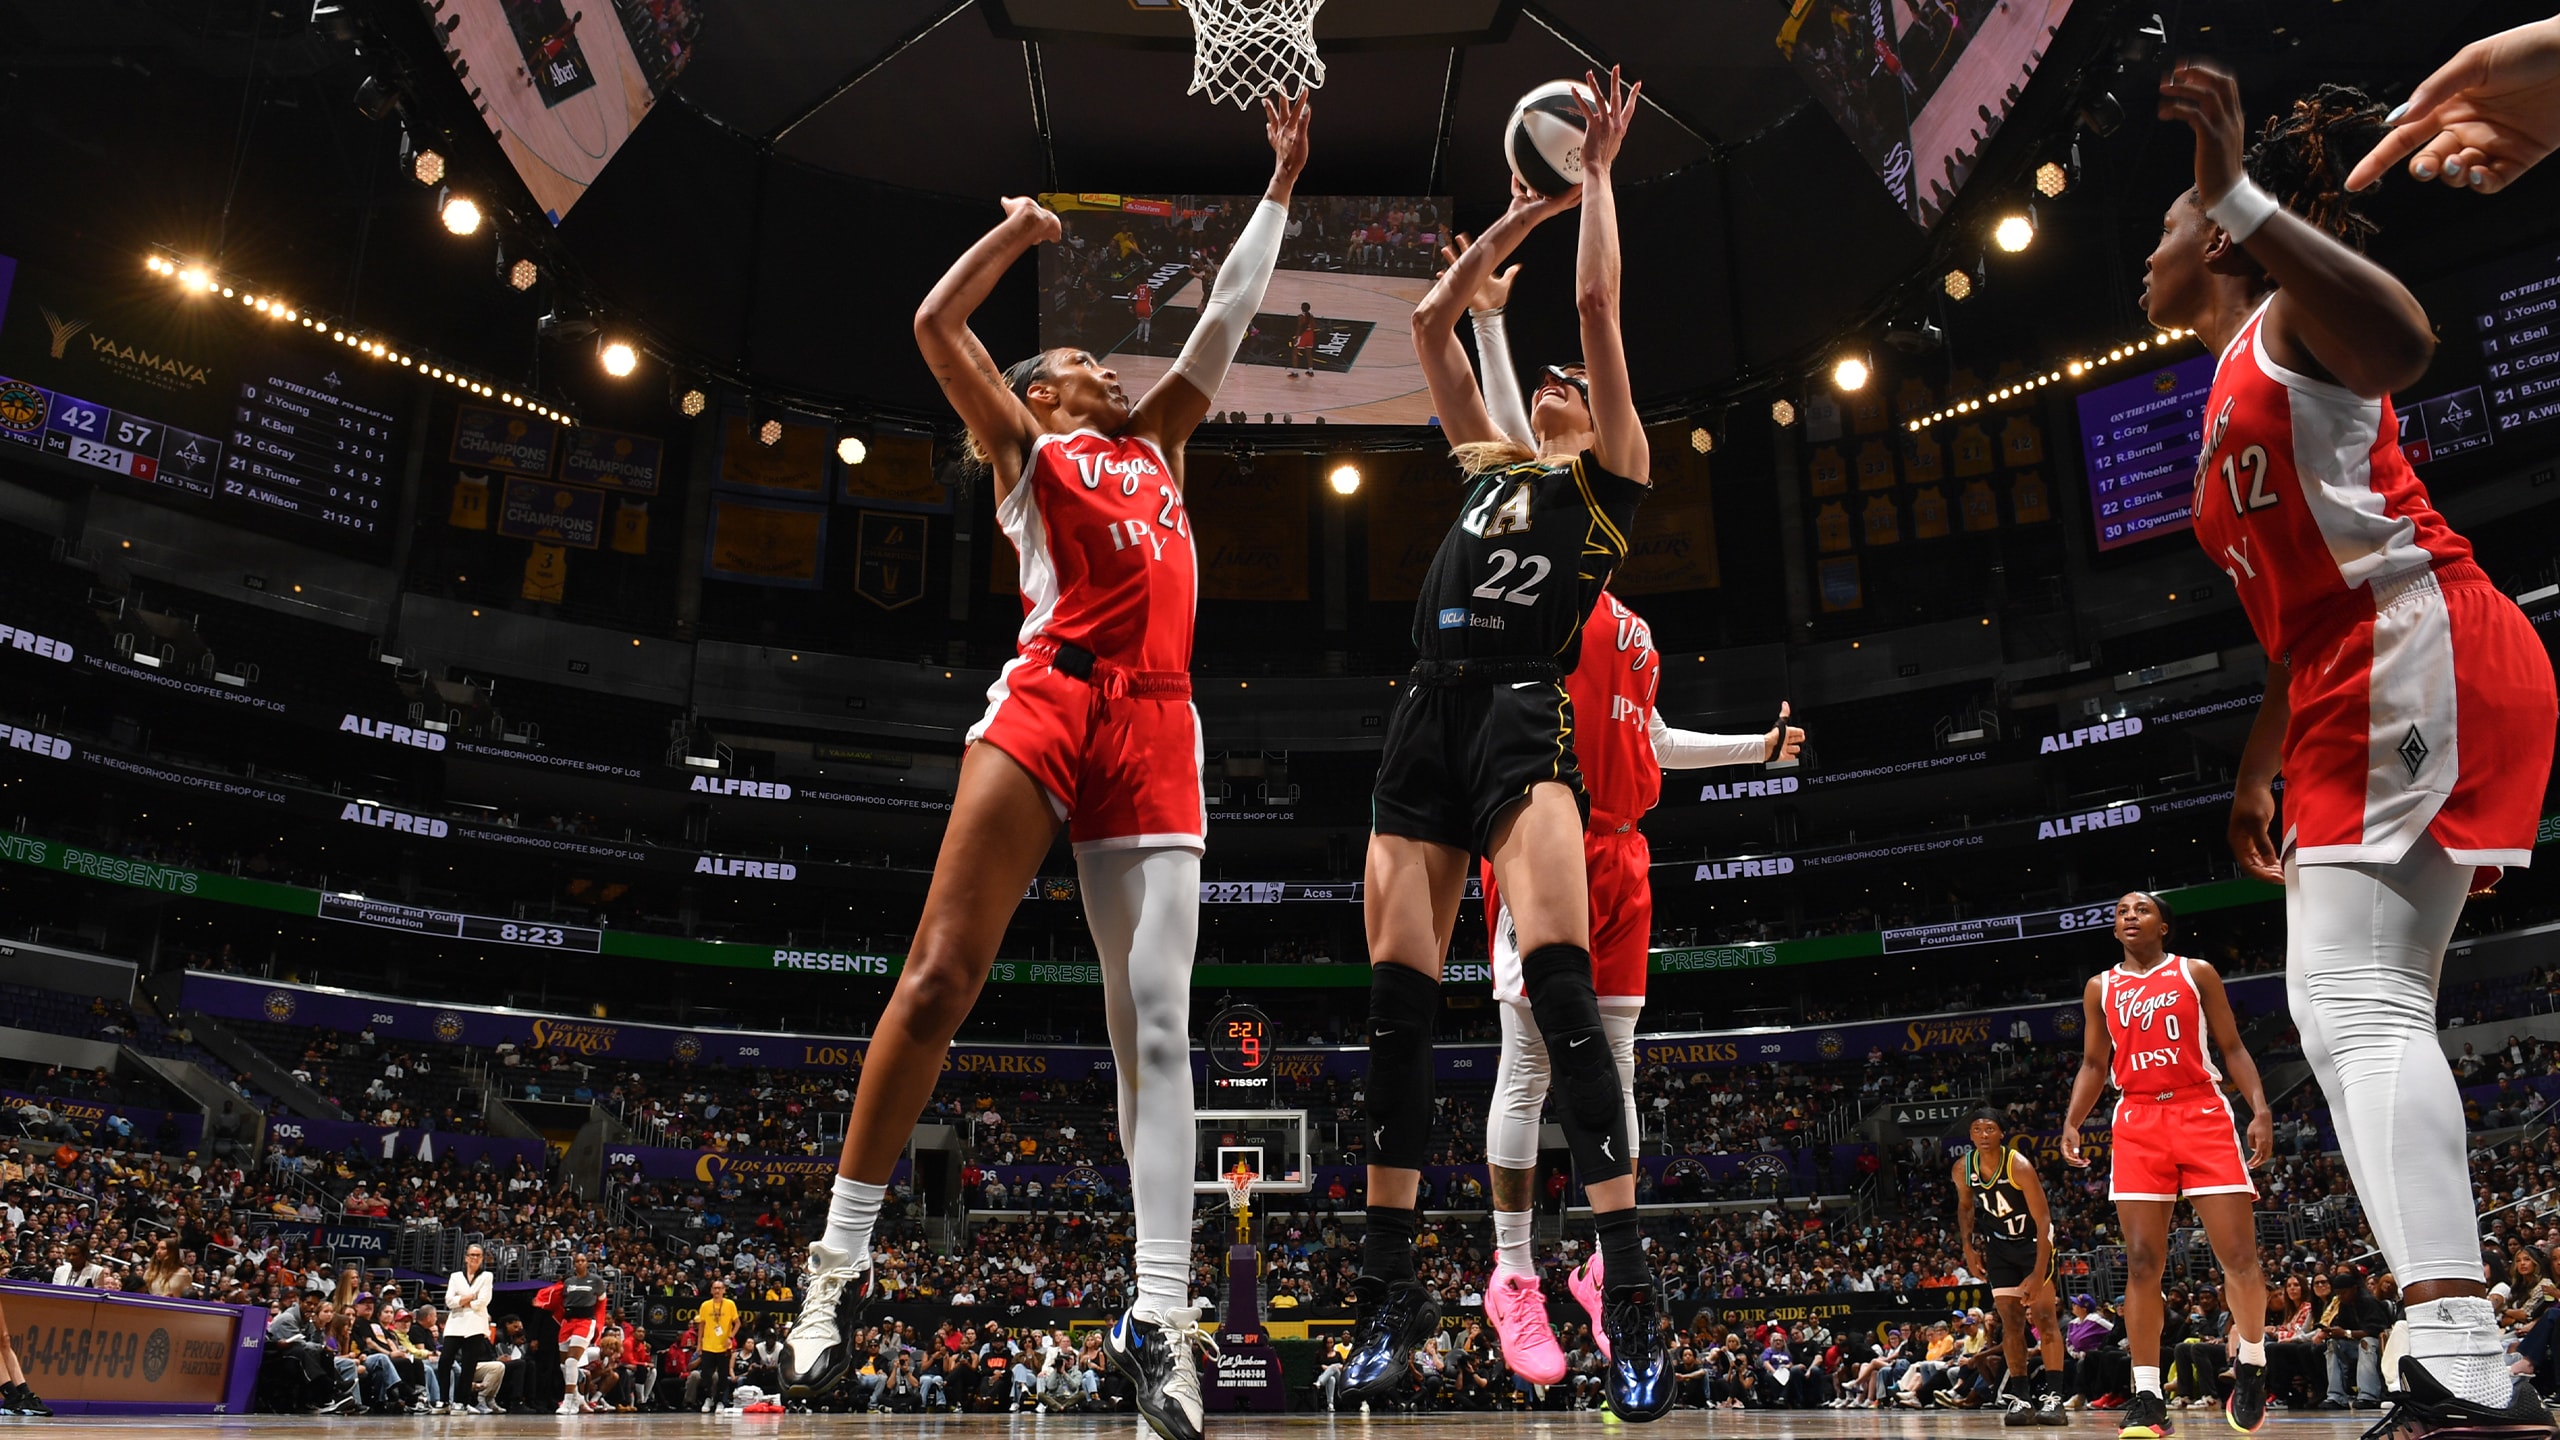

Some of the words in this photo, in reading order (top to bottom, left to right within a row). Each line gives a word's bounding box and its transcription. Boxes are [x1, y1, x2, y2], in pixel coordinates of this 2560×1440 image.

[550, 60, 577, 88] Albert
[2484, 315, 2493, 328] 0
[2504, 299, 2557, 322] J.Young
[1314, 332, 1352, 356] Albert
[2490, 339, 2498, 352] 1
[2510, 326, 2548, 346] K.Bell
[2490, 363, 2510, 379] 12
[2516, 352, 2560, 370] C.Gray
[247, 387, 255, 398] 0
[265, 395, 310, 417] J.Young
[268, 377, 284, 387] ON
[284, 382, 306, 394] THE
[305, 388, 338, 405] FLOOR
[2495, 389, 2514, 404] 21
[61, 407, 96, 432] 42
[2110, 411, 2125, 423] ON
[2125, 406, 2145, 419] THE
[2146, 396, 2178, 412] FLOOR
[2440, 410, 2472, 425] ACES
[2501, 413, 2521, 429] 22
[118, 422, 151, 446] 57
[244, 411, 250, 422] 1
[261, 417, 294, 435] K.Bell
[2096, 435, 2105, 446] 2
[2113, 424, 2149, 441] C.Gray
[48, 436, 64, 449] 3rd
[235, 433, 251, 447] 12
[257, 440, 295, 462] C.Gray
[460, 437, 547, 462] CHAMPIONS
[78, 443, 122, 468] 2:21
[176, 450, 206, 464] ACES
[521, 460, 545, 471] 2001
[2096, 456, 2112, 469] 12
[2116, 442, 2162, 463] R.Burrell
[229, 456, 246, 471] 21
[252, 464, 301, 486] B.Turner
[569, 456, 653, 480] CHAMPIONS
[2099, 479, 2114, 492] 17
[2120, 464, 2174, 486] E.Wheeler
[2222, 445, 2278, 515] 12
[225, 481, 243, 495] 22
[248, 489, 298, 510] A.Wilson
[1462, 475, 1532, 539] LA
[2102, 501, 2119, 515] 22
[2123, 491, 2163, 508] C.Brink
[507, 509, 593, 532] CHAMPIONS
[2106, 524, 2122, 538] 30
[1108, 519, 1167, 562] IPY
[541, 553, 553, 569] 3
[1472, 549, 1551, 607] 22
[1441, 612, 1466, 625] UCLA
[84, 655, 103, 668] THE
[105, 661, 182, 689] NEIGHBORHOOD
[183, 683, 222, 698] COFFEE
[224, 692, 250, 703] SHOP
[253, 697, 266, 707] OF
[268, 701, 285, 712] LOS
[2040, 717, 2143, 754] ALFRED
[2152, 714, 2171, 725] THE
[2172, 697, 2247, 721] NEIGHBORHOOD
[340, 714, 446, 751] ALFRED
[456, 742, 473, 752] THE
[476, 745, 549, 764] NEIGHBORHOOD
[550, 757, 585, 769] COFFEE
[587, 762, 610, 773] SHOP
[612, 767, 623, 776] OF
[1700, 776, 1798, 801] ALFRED
[1807, 775, 1824, 785] THE
[1825, 766, 1894, 782] NEIGHBORHOOD
[1894, 760, 1929, 772] COFFEE
[1930, 756, 1954, 768] SHOP
[1956, 754, 1968, 763] OF
[1970, 751, 1986, 762] LOS
[690, 775, 791, 800] ALFRED
[800, 790, 817, 798] THE
[819, 792, 885, 805] NEIGHBORHOOD
[888, 798, 919, 808] COFFEE
[921, 801, 943, 810] SHOP
[340, 803, 448, 838] ALFRED
[2038, 804, 2141, 840] ALFRED
[2151, 803, 2169, 813] THE
[694, 856, 796, 881] ALFRED
[1694, 857, 1794, 881] ALFRED
[1802, 857, 1820, 867] THE
[1821, 848, 1890, 864] NEIGHBORHOOD
[1891, 842, 1926, 855] COFFEE
[1927, 840, 1951, 851] SHOP
[1952, 838, 1965, 846] OF
[1966, 834, 1983, 844] LOS
[63, 849, 198, 894] PRESENTS
[1208, 884, 1254, 902] 2:21
[1270, 890, 1279, 902] 3
[1303, 889, 1333, 898] Aces
[323, 894, 400, 914] Development
[403, 908, 424, 919] and
[427, 910, 461, 924] Youth
[359, 910, 424, 929] Foundation
[500, 924, 564, 946] 8:23
[1885, 924, 1958, 940] Development
[1961, 921, 1982, 930] and
[1984, 916, 2019, 928] Youth
[1920, 931, 1984, 945] Foundation
[773, 949, 889, 975] PRESENTS
[1660, 946, 1776, 971] PRESENTS
[2115, 988, 2136, 1008] Las
[2119, 986, 2180, 1030] Vegas
[372, 1013, 394, 1024] 205
[1229, 1022, 1262, 1037] 2:21
[2165, 1014, 2180, 1040] 0
[529, 1019, 616, 1056] SPARKS
[1902, 1020, 1990, 1051] SPARKS
[739, 1046, 759, 1057] 206
[805, 1046, 848, 1066] LOS
[1242, 1038, 1259, 1066] 9
[1647, 1043, 1738, 1064] SPARKS
[1761, 1045, 1781, 1053] 209
[2131, 1048, 2180, 1072] IPSY
[958, 1054, 1047, 1074] SPARKS
[1094, 1060, 1112, 1070] 207
[1453, 1060, 1472, 1068] 208
[729, 1159, 761, 1172] LOS
[762, 1159, 835, 1176] ANGELES
[1979, 1190, 2013, 1218] LA
[2004, 1214, 2026, 1235] 17
[327, 1233, 382, 1250] ULTRA
[183, 1340, 225, 1360] PROUD
[241, 1336, 258, 1348] Albert
[180, 1361, 222, 1376] PARTNER
